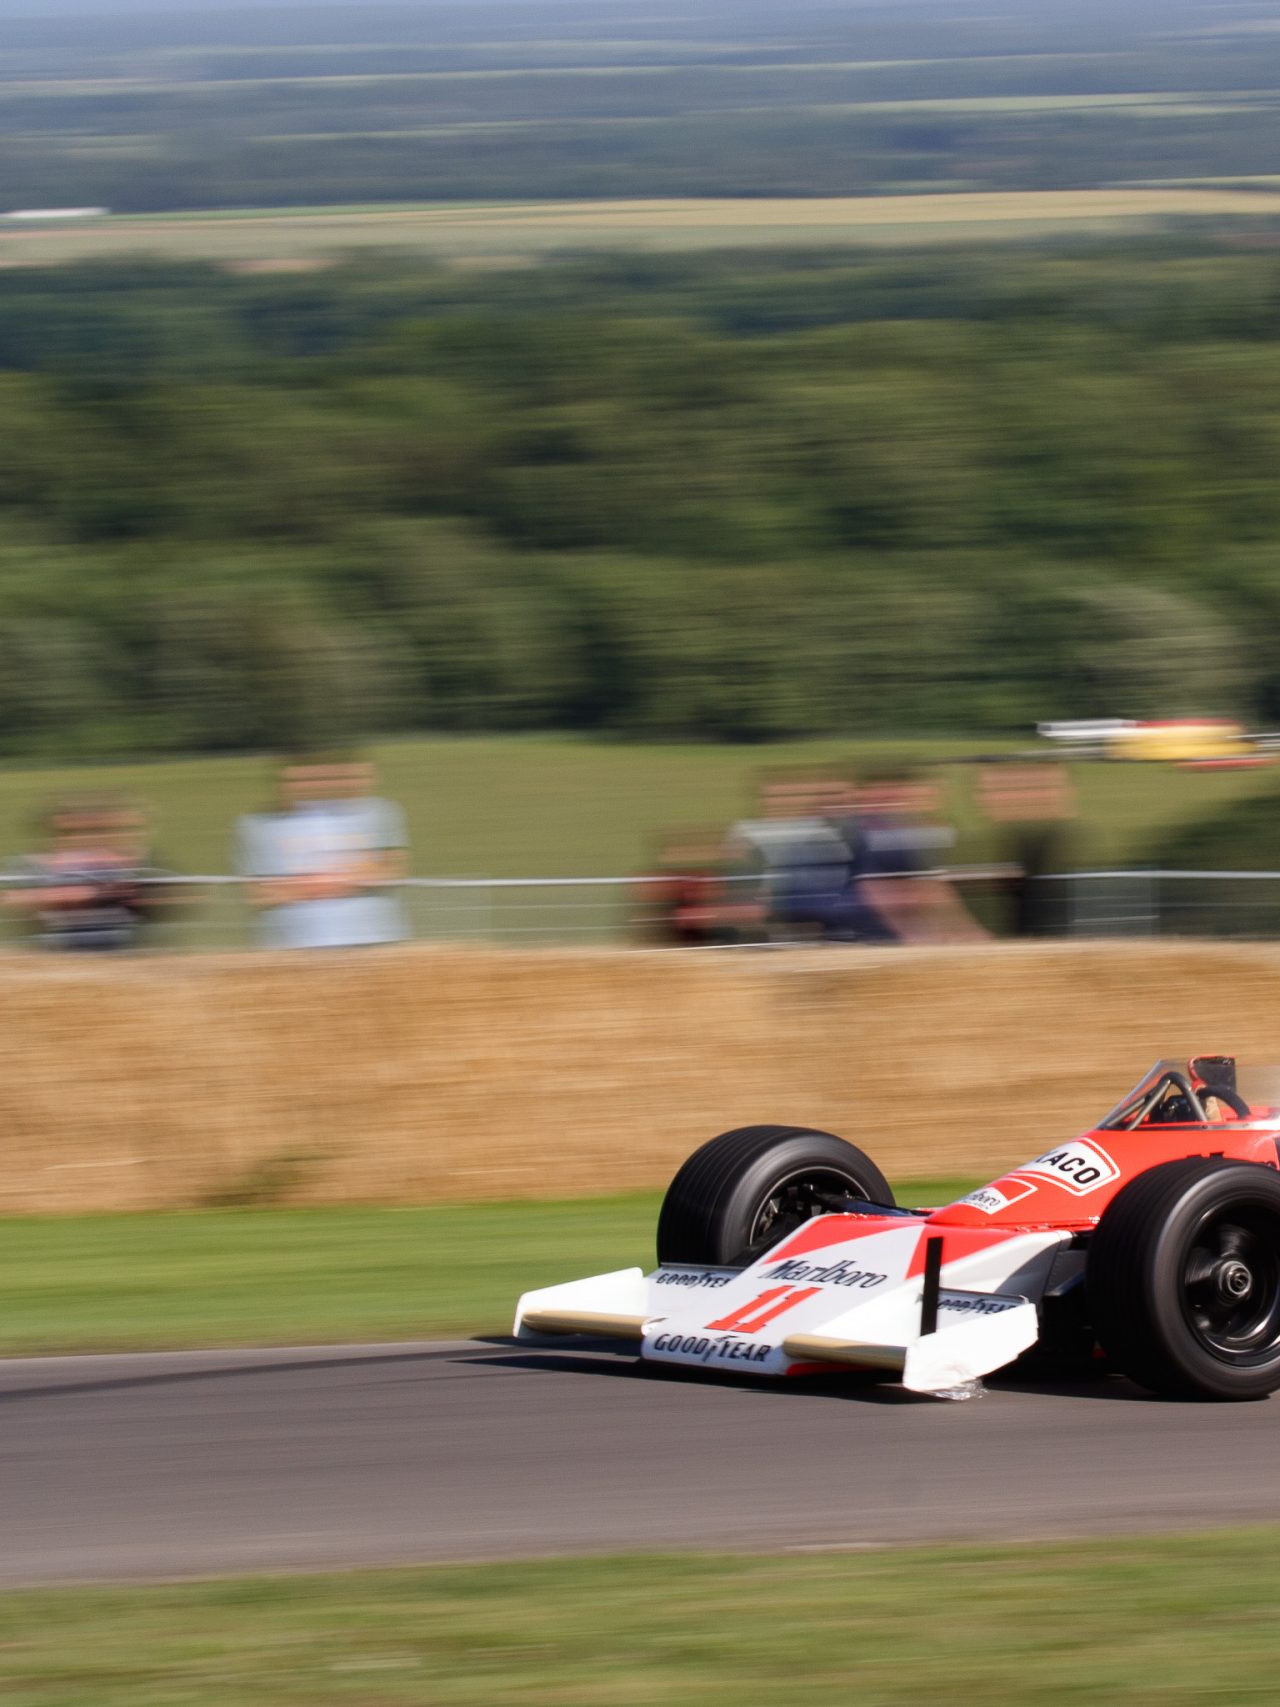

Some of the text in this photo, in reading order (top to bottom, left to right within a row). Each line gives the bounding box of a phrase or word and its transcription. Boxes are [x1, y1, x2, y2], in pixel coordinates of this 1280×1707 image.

[756, 1259, 888, 1289] Marlboro
[704, 1284, 823, 1334] 11
[653, 1333, 774, 1363] GOODYEAR
